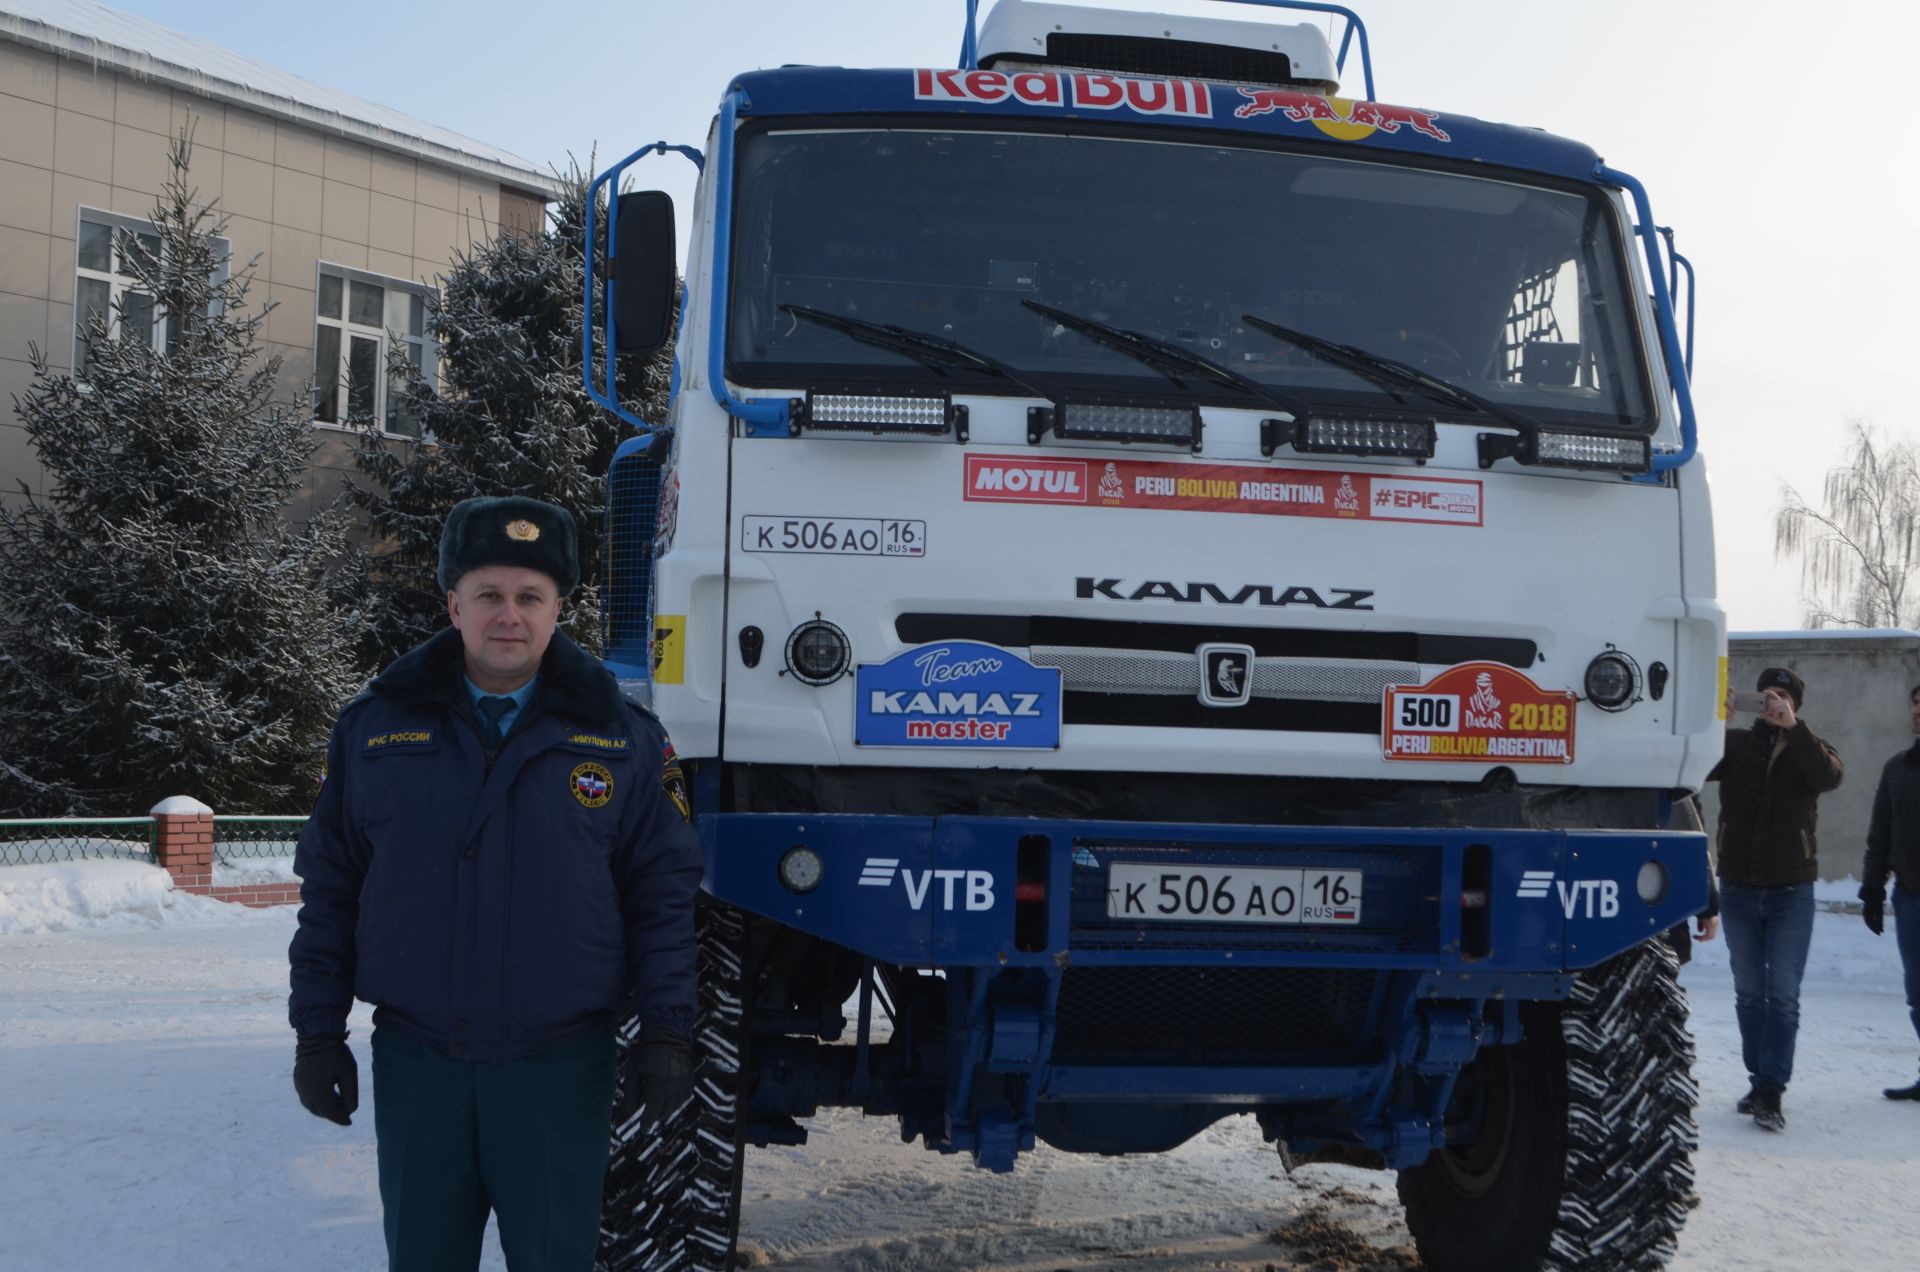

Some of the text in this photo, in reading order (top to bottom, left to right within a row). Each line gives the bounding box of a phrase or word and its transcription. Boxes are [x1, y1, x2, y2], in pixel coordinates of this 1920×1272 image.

[920, 68, 1211, 117] Red Bull
[974, 467, 1080, 494] MOTUL
[1135, 475, 1325, 504] PERU BOLIVIA ARGENTINA
[887, 522, 915, 543] 16
[887, 544, 908, 553] RUS
[1075, 577, 1375, 611] KAMAZ
[914, 648, 1002, 687] Team
[871, 690, 1041, 717] KAMAZ
[1401, 697, 1451, 728] 500
[1508, 702, 1567, 732] 2018
[906, 717, 1012, 740] master
[1465, 708, 1504, 730] DAKAR
[367, 731, 431, 748] МЧС РОССИИ
[901, 868, 996, 912] VTB
[1313, 876, 1350, 906] 16
[1556, 879, 1620, 920] VTB
[1303, 906, 1333, 919] RUS
